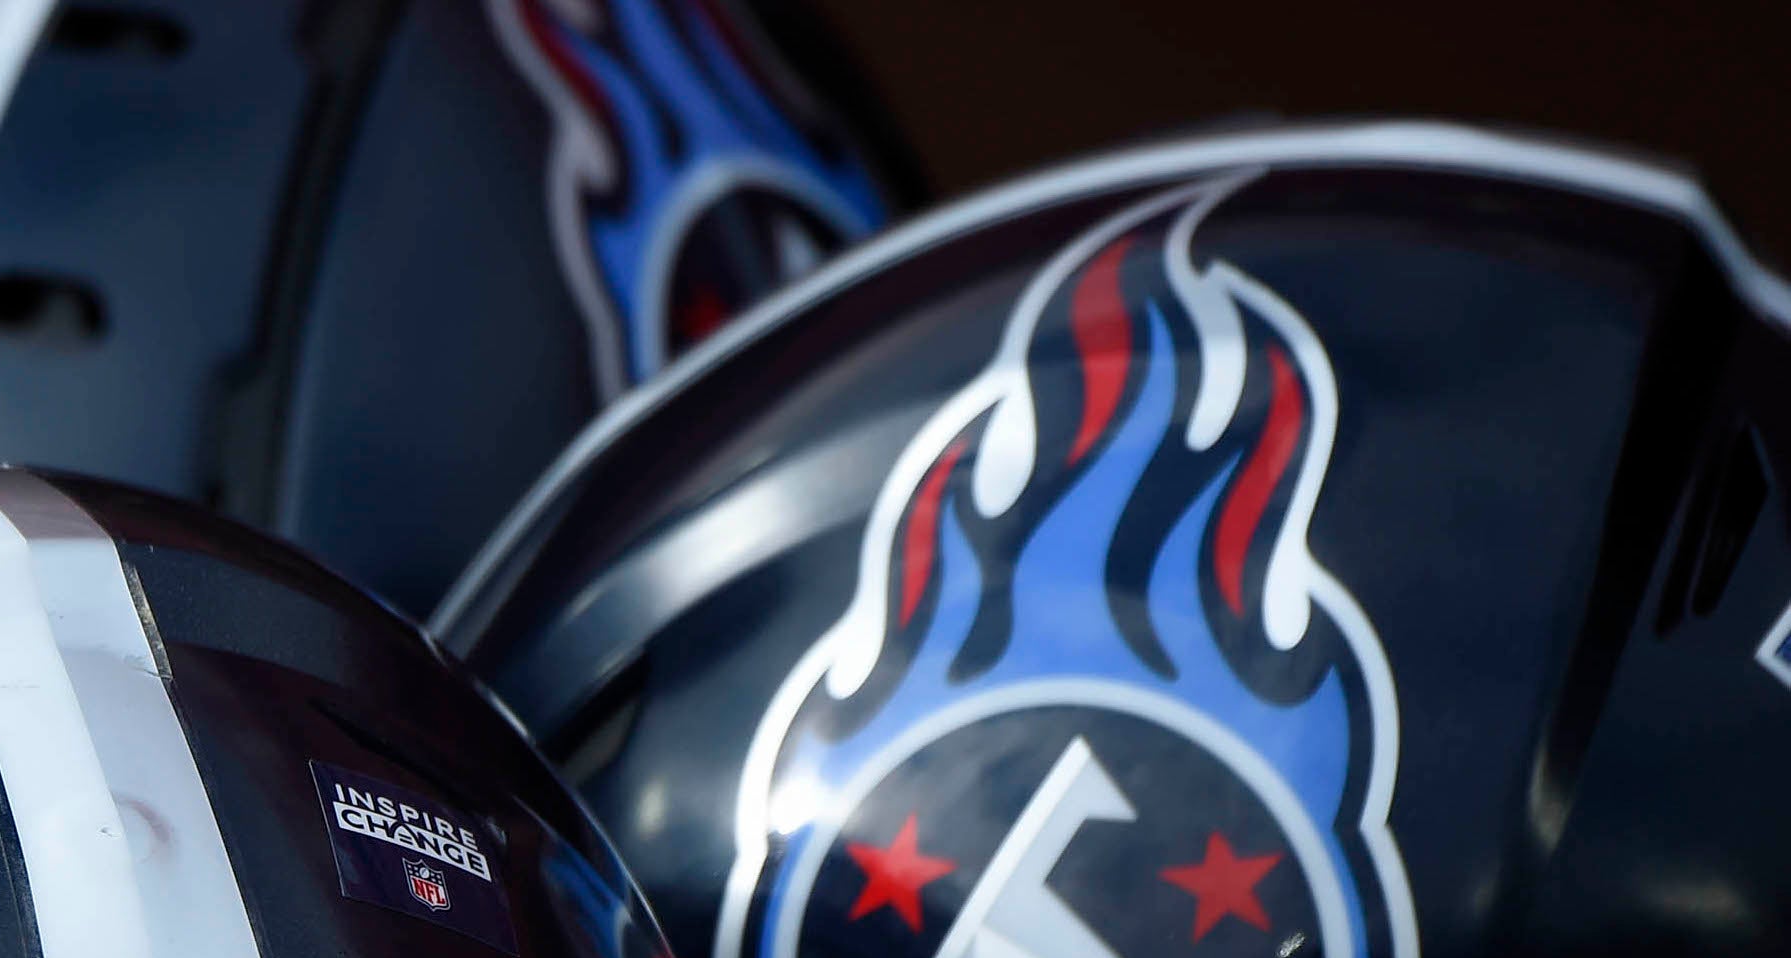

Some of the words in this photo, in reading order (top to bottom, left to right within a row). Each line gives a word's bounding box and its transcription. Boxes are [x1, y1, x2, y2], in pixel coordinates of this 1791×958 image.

[334, 782, 479, 851] INSPIRE
[339, 808, 486, 878] CHANGE
[412, 879, 446, 905] NFL
